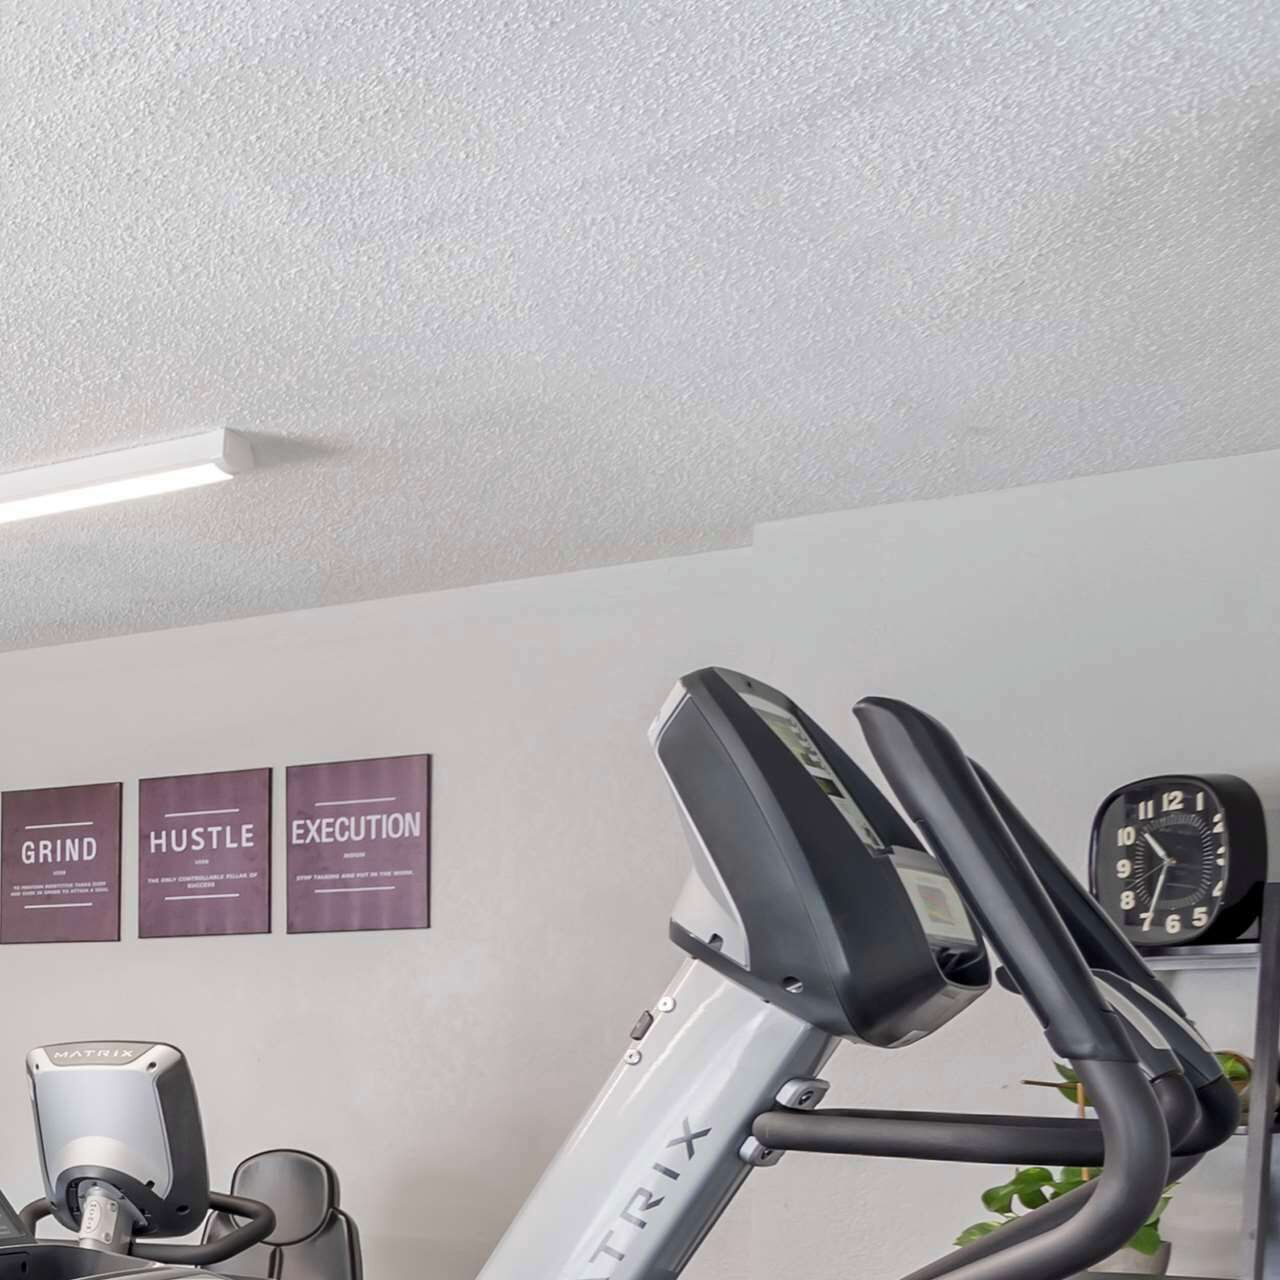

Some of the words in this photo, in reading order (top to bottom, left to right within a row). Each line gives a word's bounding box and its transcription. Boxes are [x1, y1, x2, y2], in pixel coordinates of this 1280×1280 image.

[1138, 799, 1154, 820] 11
[1162, 790, 1185, 812] 12
[1196, 791, 1205, 811] 1
[150, 823, 254, 853] HUSTLE
[292, 811, 421, 845] EXECUTION
[1117, 826, 1136, 846] 10
[21, 837, 97, 864] GRIND
[1116, 858, 1132, 878] 9
[1120, 890, 1136, 910] 8
[1139, 911, 1154, 932] 7
[1165, 914, 1182, 934] 6
[1192, 906, 1208, 927] 5
[53, 1049, 134, 1059] MATRIX
